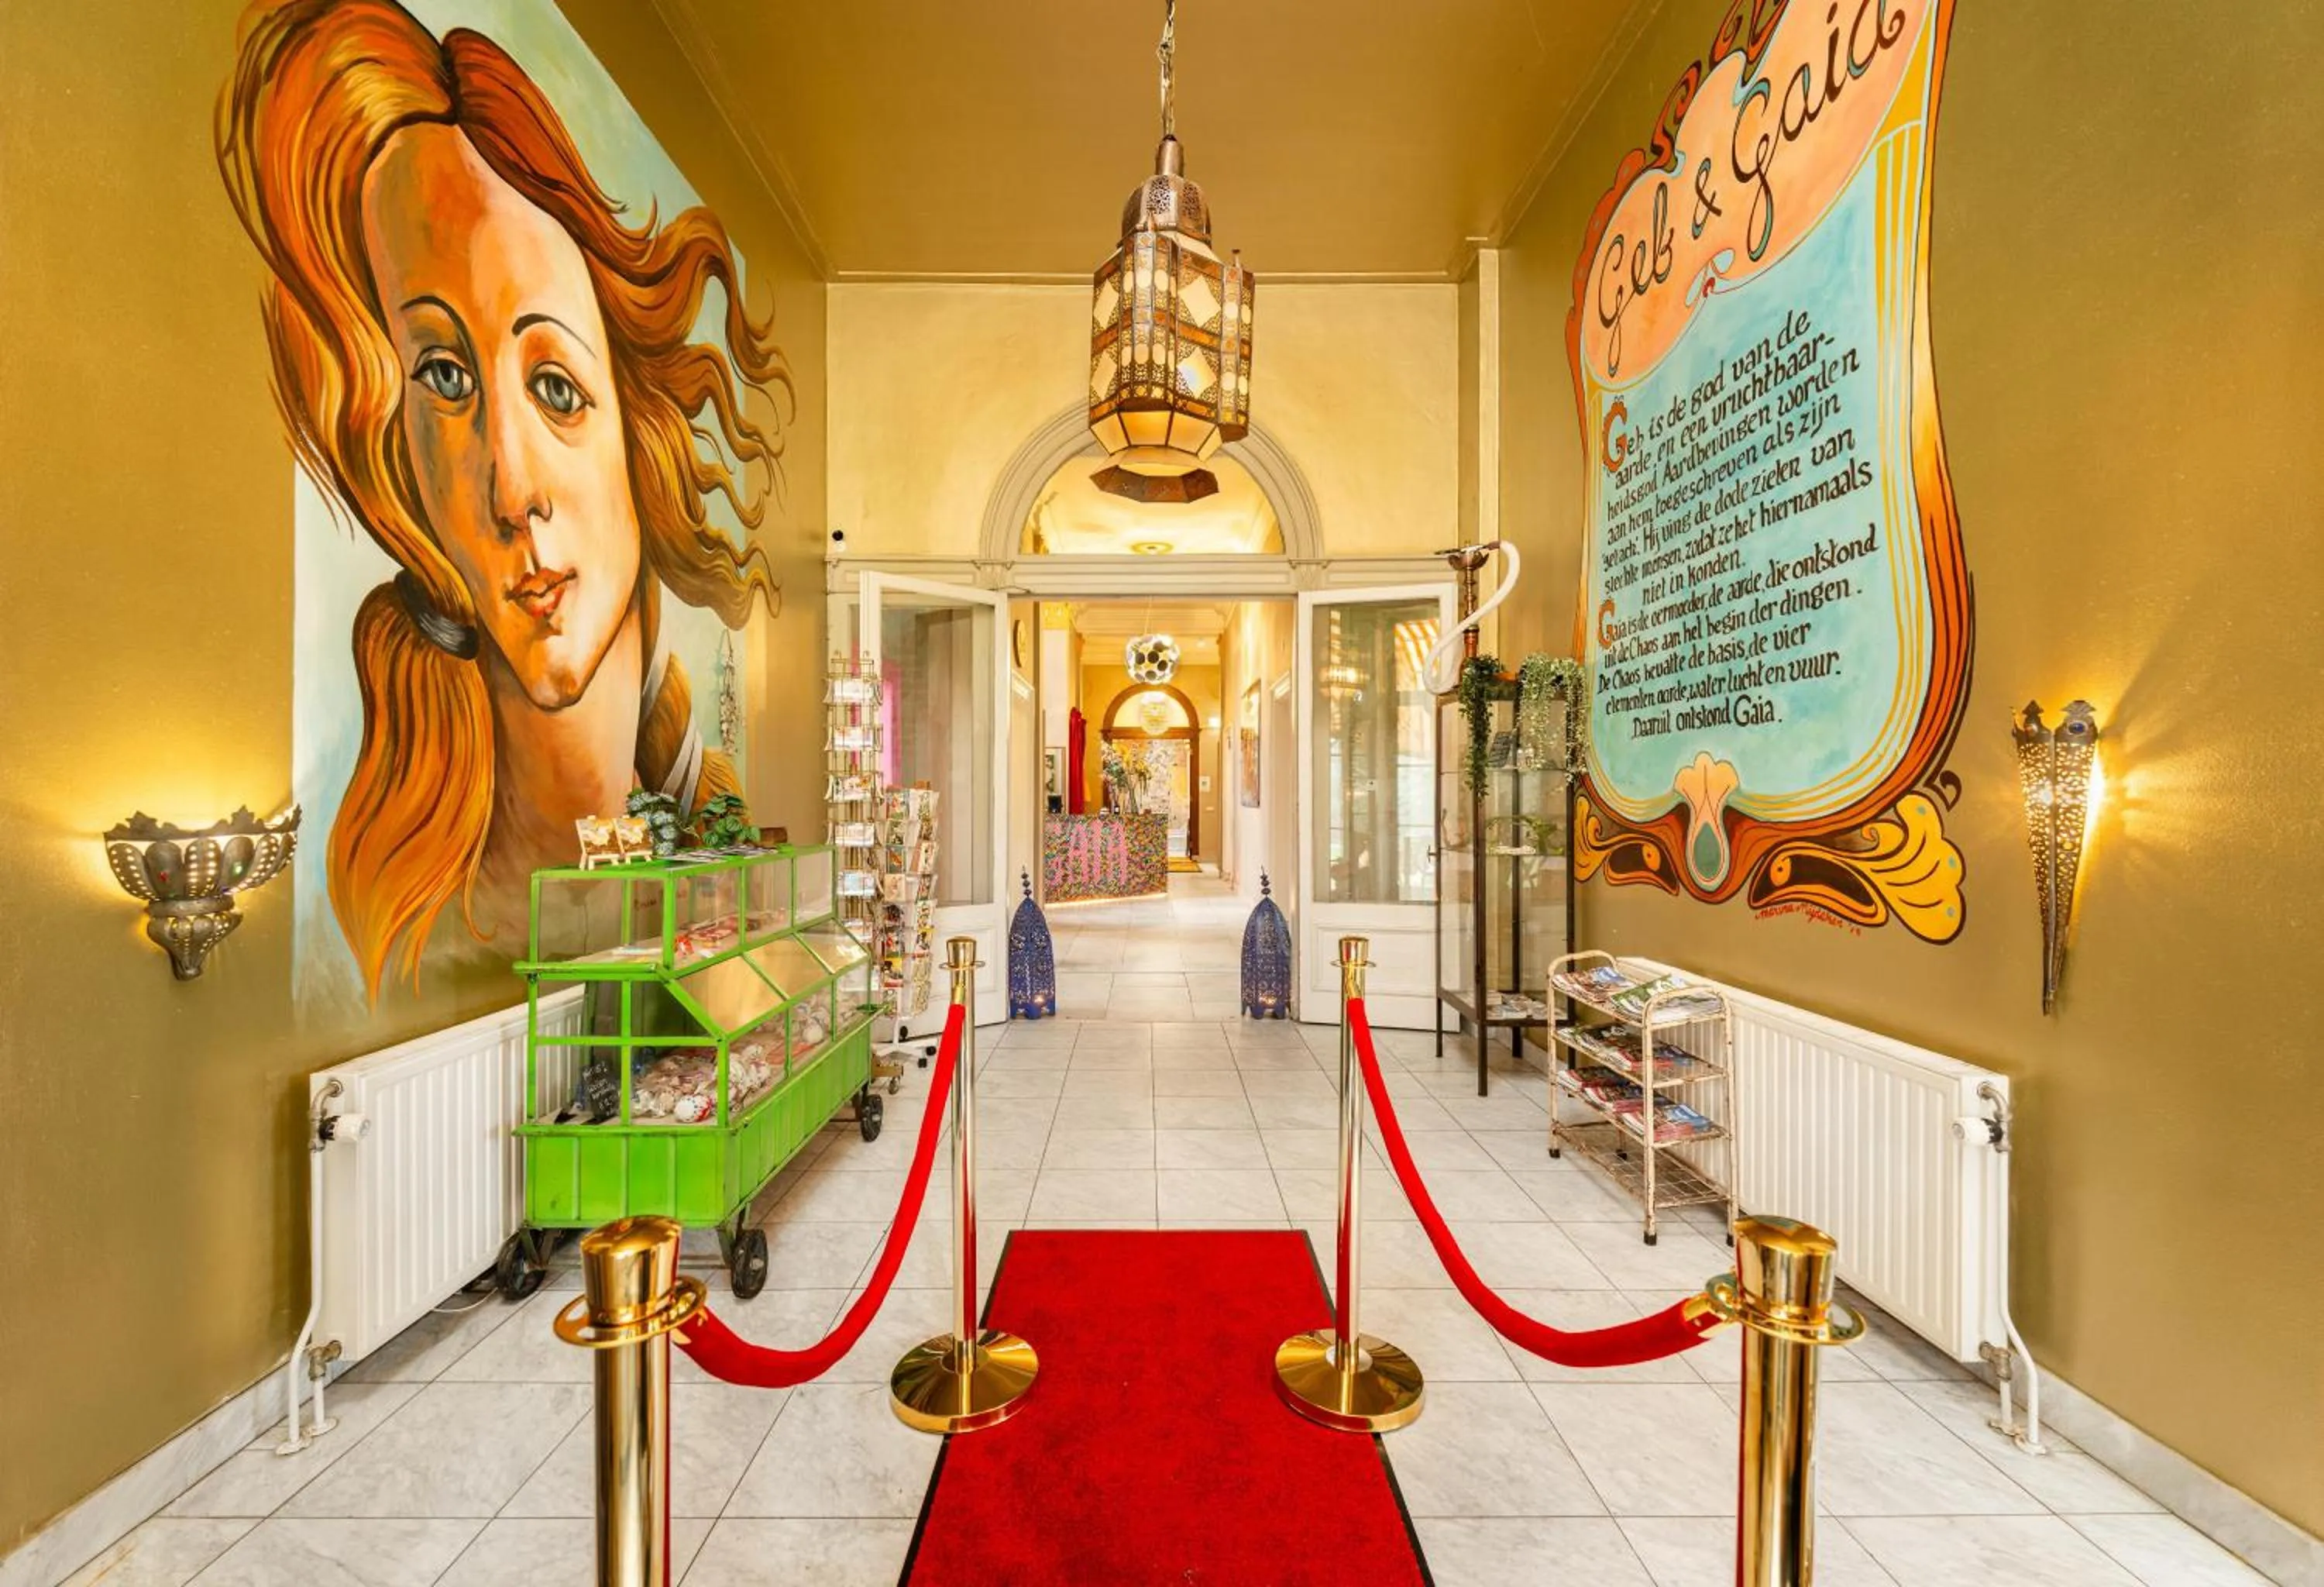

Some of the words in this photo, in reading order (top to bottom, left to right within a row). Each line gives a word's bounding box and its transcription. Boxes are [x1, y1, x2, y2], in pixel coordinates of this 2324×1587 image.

[1598, 181, 1675, 378] Geb
[1692, 157, 1722, 240] &
[1731, 0, 1906, 262] Gaia
[1602, 400, 1645, 473] Geb
[1648, 415, 1665, 440] is
[1667, 394, 1686, 427] de
[1691, 360, 1726, 415] god
[1732, 338, 1774, 382] van
[1777, 309, 1810, 350] de
[1616, 449, 1651, 490] aarde
[1657, 436, 1675, 462] en
[1680, 416, 1708, 448] een
[1712, 332, 1834, 426] vruchtbaar-
[1662, 404, 1772, 487] Aardbevingen
[1777, 348, 1861, 417] worden
[1607, 522, 1627, 546] aan
[1629, 508, 1654, 533] hem
[1655, 445, 1758, 518] toegeschreven
[1762, 421, 1794, 455] als
[1799, 394, 1841, 439] zijn
[1643, 523, 1661, 555] Hij
[1662, 510, 1690, 542] ving
[1694, 501, 1711, 525] de
[1714, 479, 1748, 516] dode
[1752, 456, 1802, 496] zielen
[1812, 428, 1855, 466] van
[1685, 524, 1717, 559] zodat
[1718, 523, 1734, 546] ze
[1735, 508, 1755, 541] het
[1760, 457, 1873, 527] hiernamaals
[1643, 577, 1666, 606] niet
[1670, 571, 1684, 594] in
[1687, 549, 1746, 587] konden.
[1708, 583, 1724, 608] de
[1765, 559, 1790, 589] die
[1793, 522, 1881, 579] ontstond
[1597, 673, 1611, 695] De
[1612, 668, 1642, 690] Chaos
[1644, 652, 1686, 681] bevatte
[1688, 642, 1705, 669] de
[1748, 632, 1769, 658] de
[1772, 622, 1812, 650] vier
[1629, 635, 1659, 661] Chaos
[1662, 631, 1682, 651] aan
[1683, 614, 1703, 643] het
[1706, 609, 1747, 637] begin
[1749, 597, 1779, 625] der
[1728, 659, 1765, 694] lucht
[1765, 665, 1786, 684] en
[1788, 651, 1842, 682] vuur.
[1631, 708, 1672, 740] Daaruit
[1676, 697, 1732, 731] ontstond
